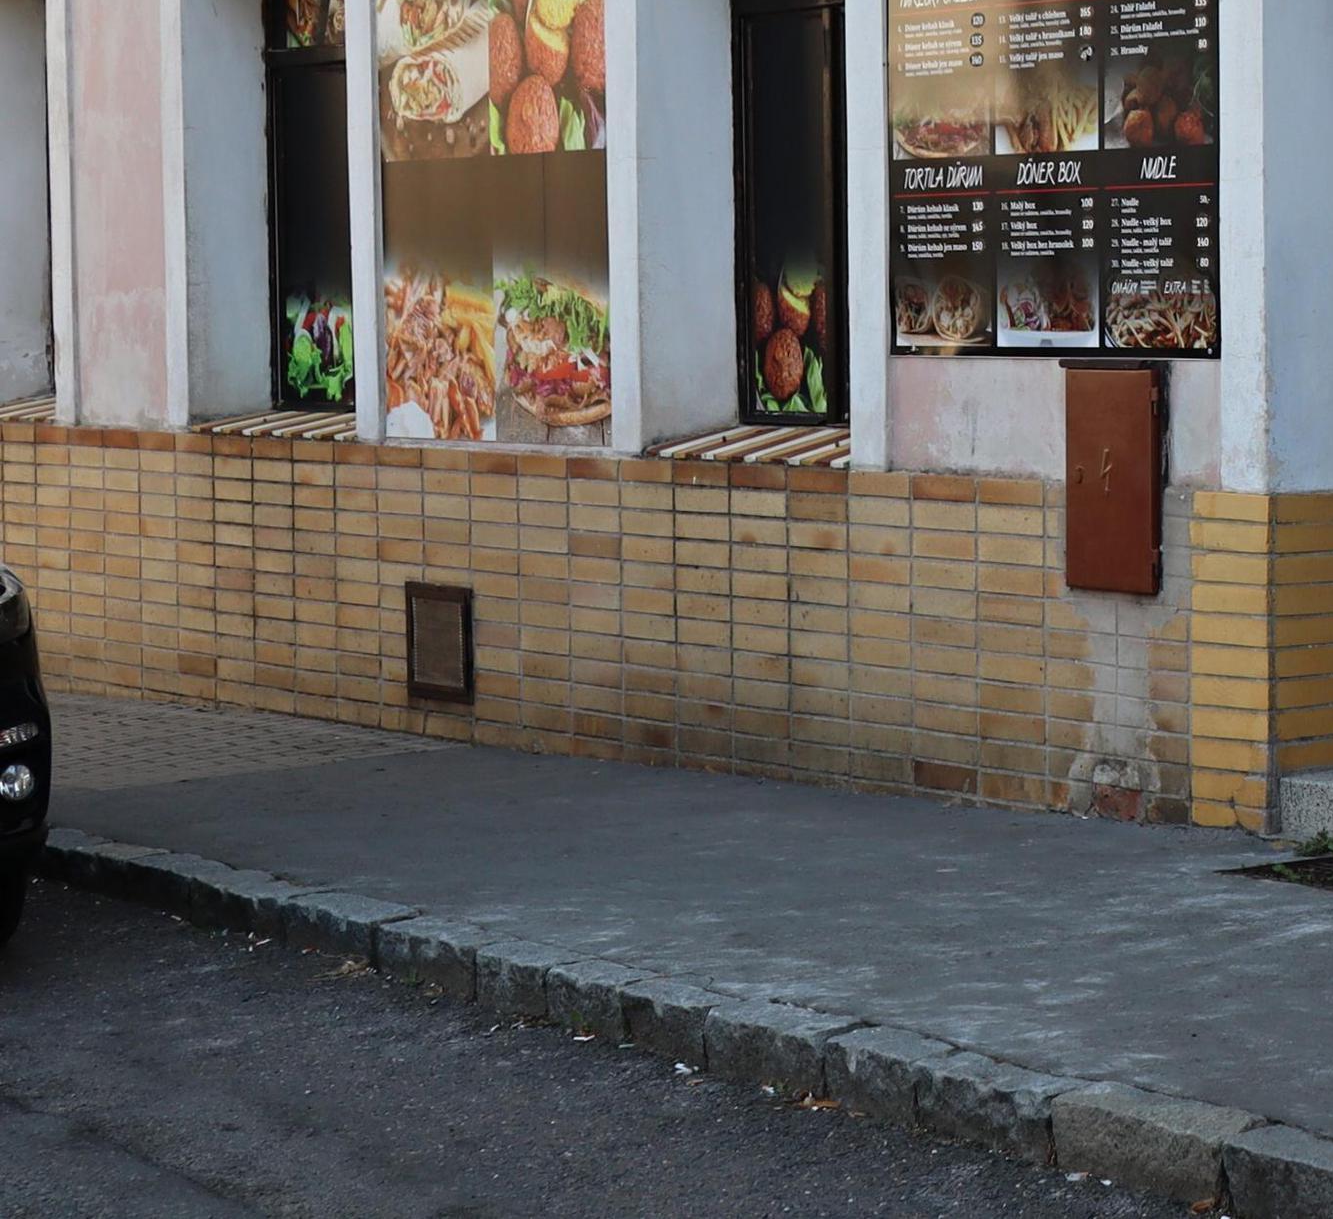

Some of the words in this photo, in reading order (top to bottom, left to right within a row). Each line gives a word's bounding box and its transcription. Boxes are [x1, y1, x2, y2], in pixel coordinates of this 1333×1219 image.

[1195, 17, 1206, 27] 110
[1198, 39, 1207, 49] 80
[1017, 158, 1055, 185] DÖNER
[1058, 161, 1081, 185] BOX
[1140, 156, 1176, 179] NUDLE
[904, 167, 943, 190] TORTILA
[1082, 220, 1094, 229] 120
[1196, 217, 1208, 227] 120
